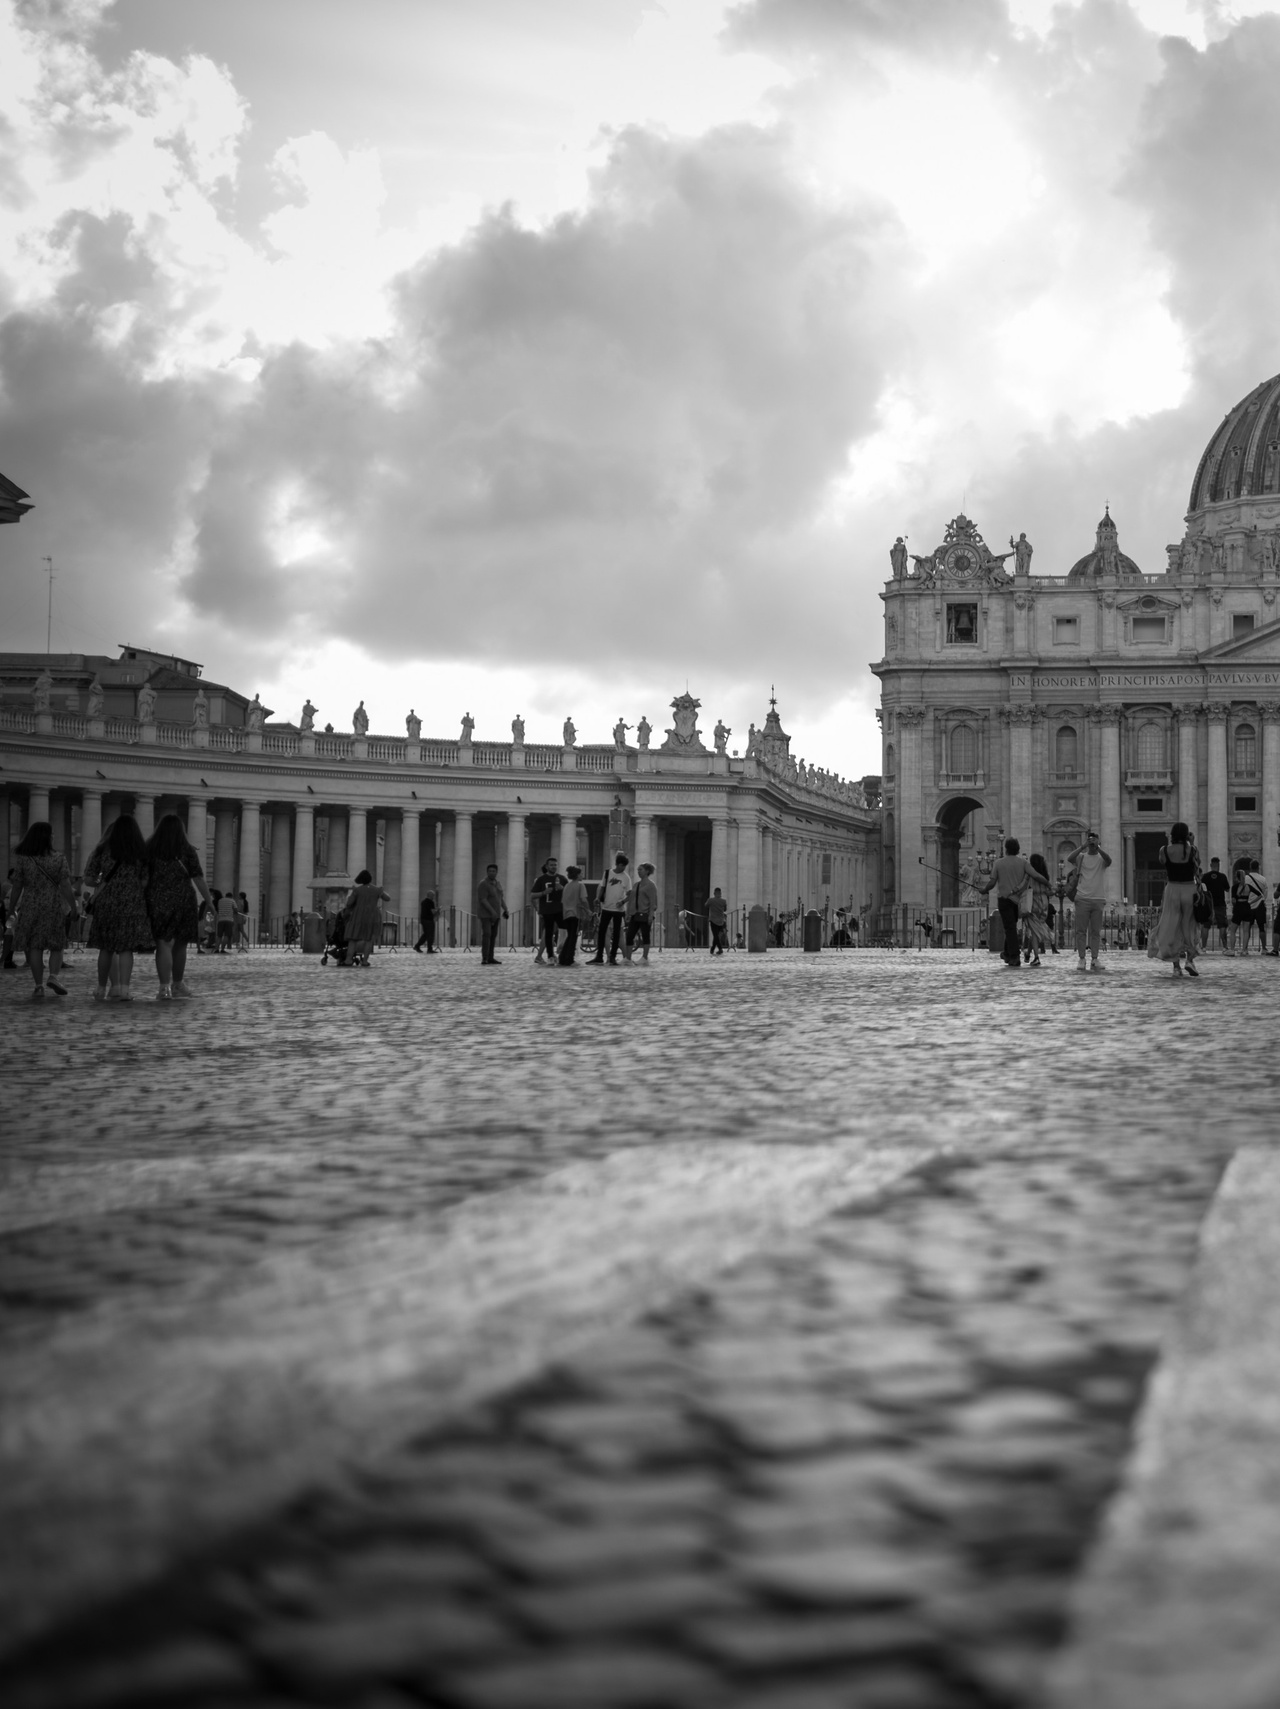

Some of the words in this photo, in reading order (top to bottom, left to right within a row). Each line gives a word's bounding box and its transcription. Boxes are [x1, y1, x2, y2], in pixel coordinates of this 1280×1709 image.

[1010, 676, 1026, 687] IN
[1032, 677, 1098, 687] HONOREM
[1101, 675, 1166, 686] PRINCIPIS
[1167, 674, 1207, 685] APOST
[1209, 673, 1251, 684] PAVLVS
